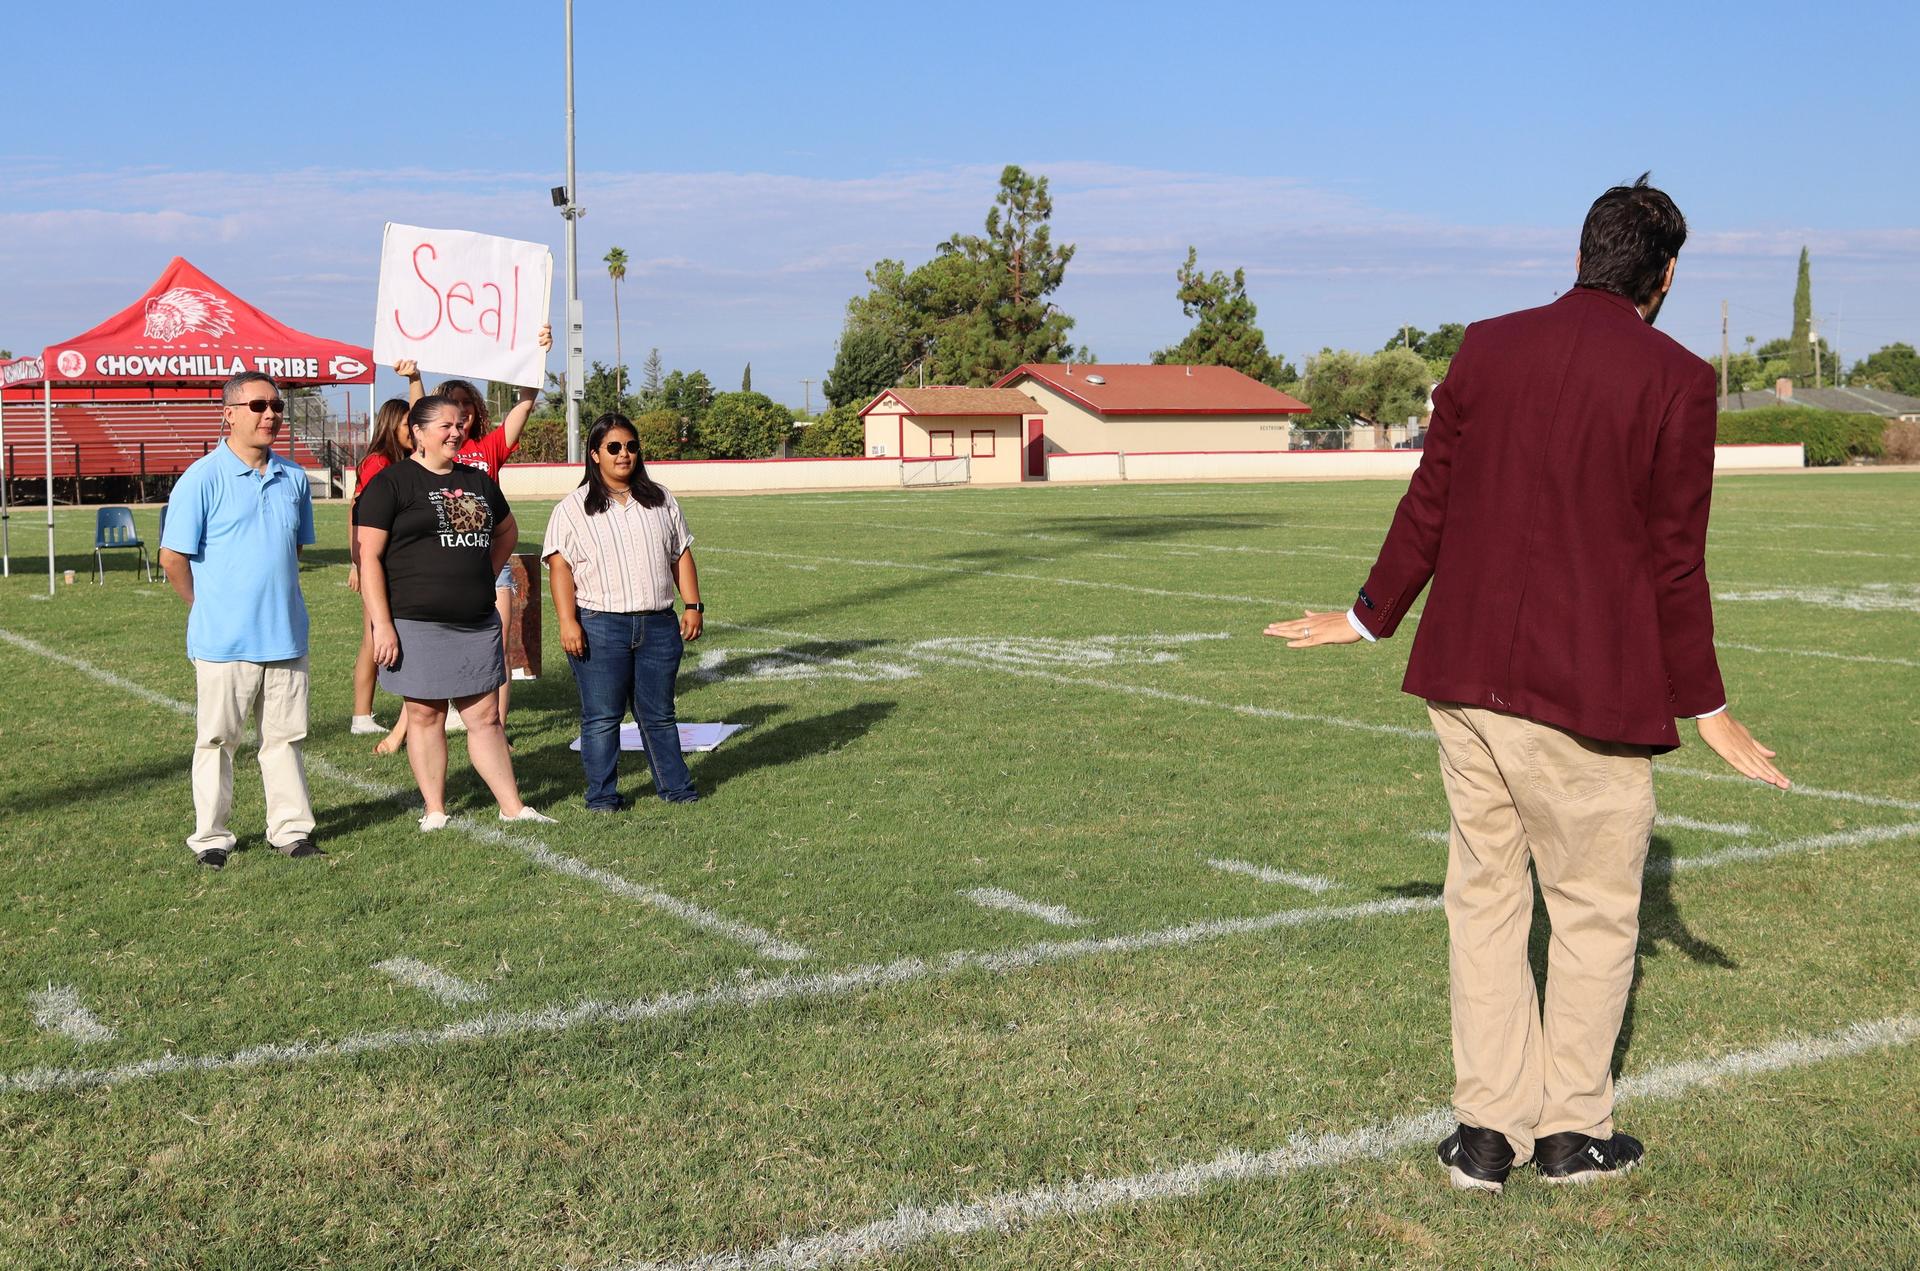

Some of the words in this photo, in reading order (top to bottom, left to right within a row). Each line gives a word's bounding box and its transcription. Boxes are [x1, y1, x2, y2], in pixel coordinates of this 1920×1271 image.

[394, 243, 519, 351] Seal
[95, 354, 247, 376] CHOWCHILLA
[253, 355, 319, 378] TRIBE
[440, 532, 490, 548] TEACHER
[1588, 1145, 1604, 1164] FILA
